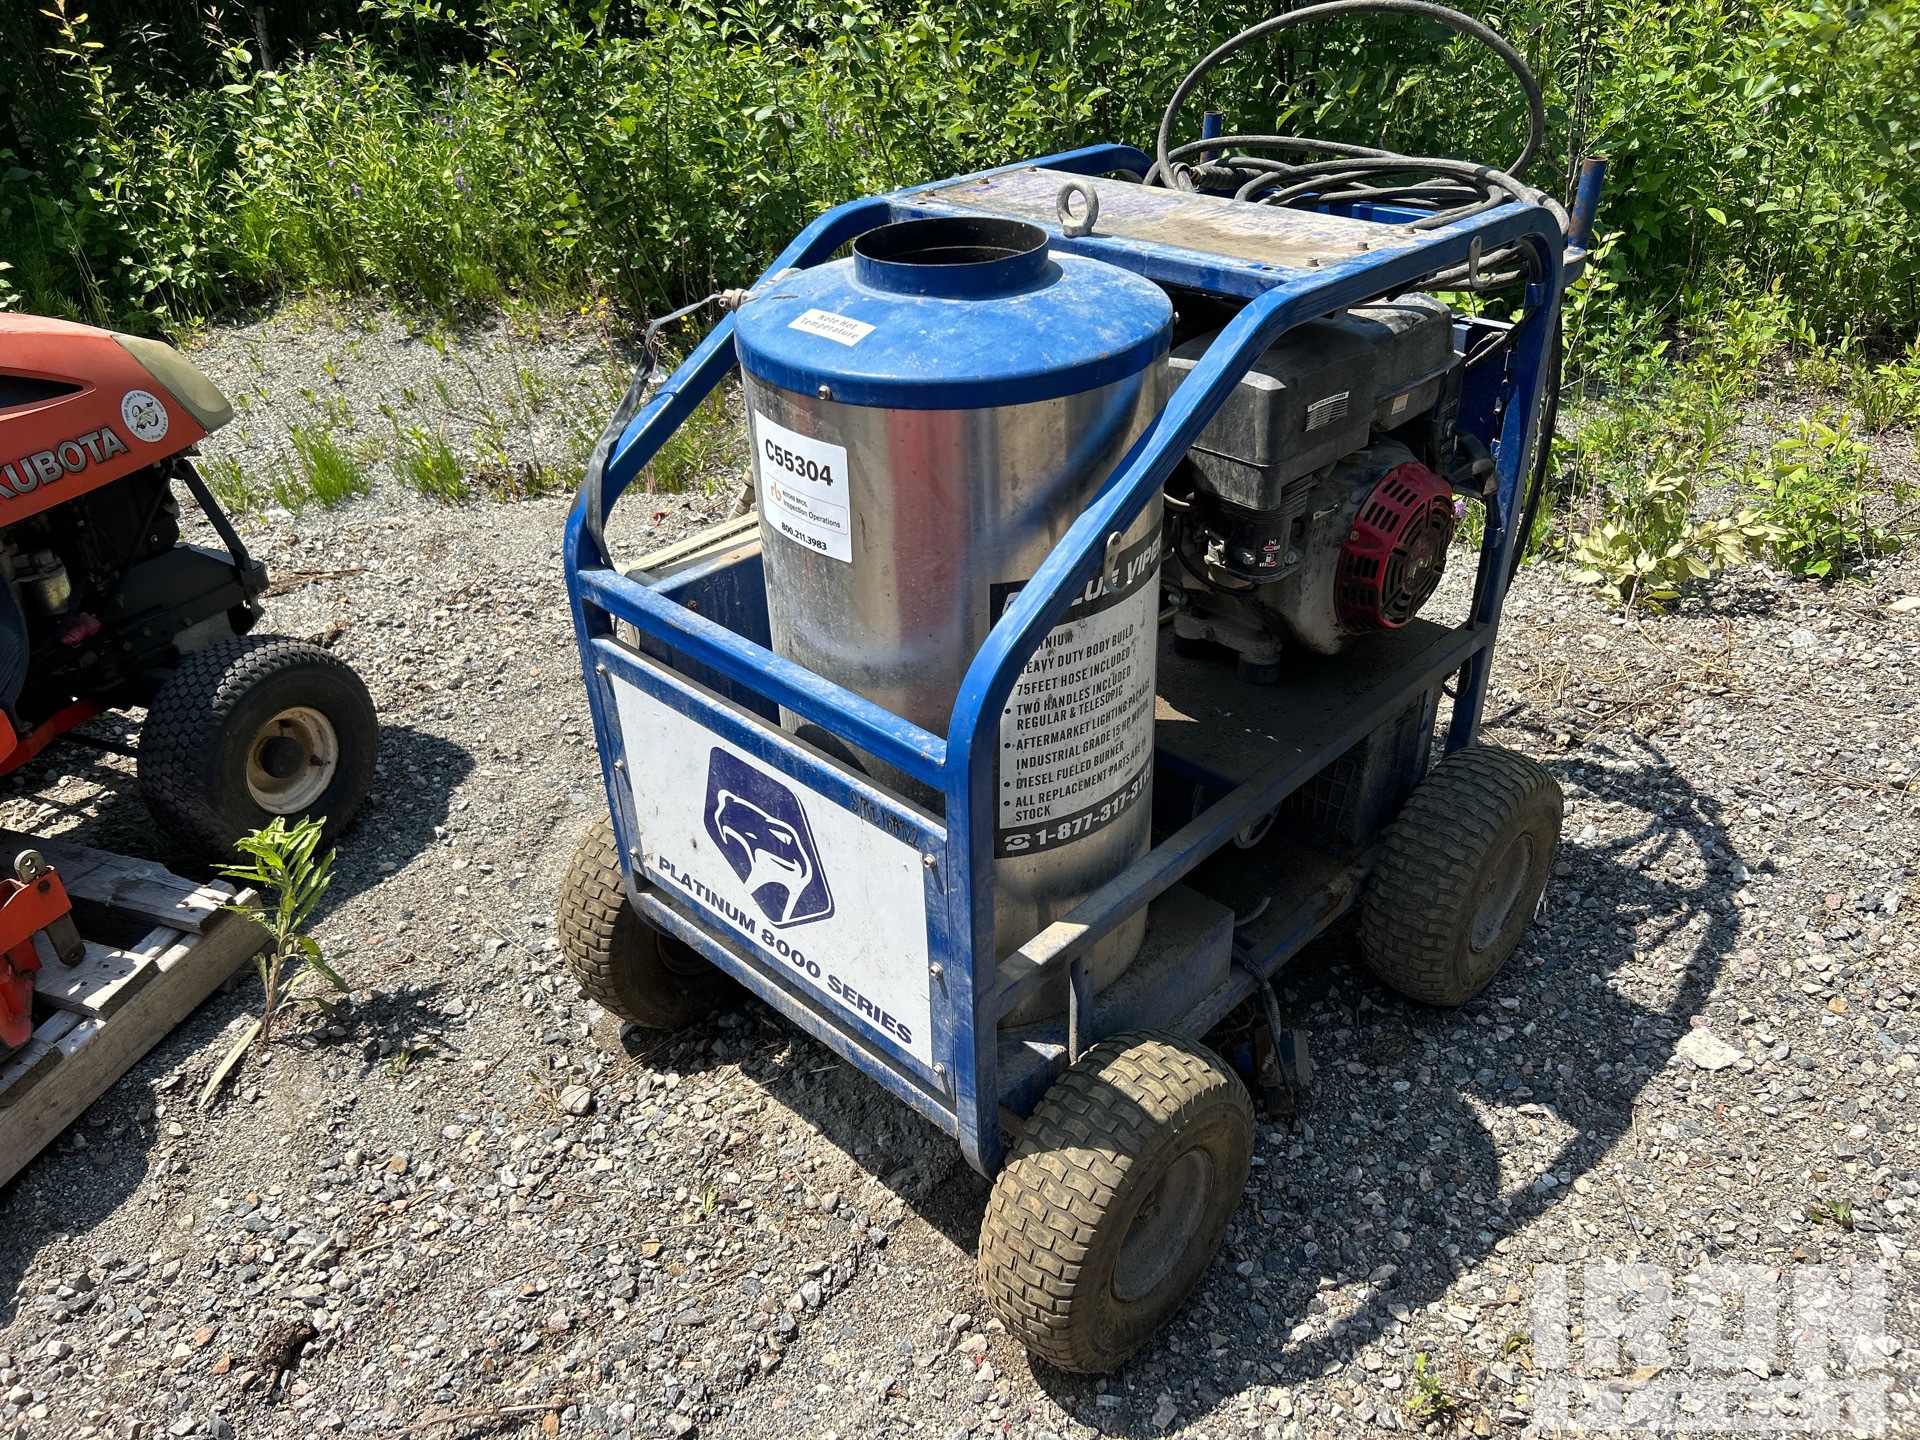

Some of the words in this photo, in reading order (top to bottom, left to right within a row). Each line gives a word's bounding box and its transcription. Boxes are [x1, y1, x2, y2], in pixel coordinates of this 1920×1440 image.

[800, 317, 859, 340] Temperature
[765, 438, 834, 487] C55304
[781, 521, 828, 551] 800.211.3983
[783, 499, 808, 517] Inspection
[808, 511, 841, 529] Operations
[1057, 648, 1084, 668] DUTY
[1086, 637, 1111, 658] BODY
[1111, 624, 1134, 647] BUILD
[1016, 677, 1058, 696] 75FEET
[1060, 668, 1088, 688] HOSE
[1090, 646, 1131, 677] INCLUDED
[1016, 701, 1040, 716] TWO
[1043, 687, 1091, 711] HANDLES
[1092, 665, 1131, 696] INCLUDED
[1016, 709, 1067, 731] REGULAR
[1069, 706, 1077, 719] &
[1079, 684, 1124, 715] TELESOPIC
[1016, 720, 1091, 751] AFTERMARKET
[1092, 700, 1128, 730] LIGHTING
[1016, 749, 1081, 770] INDUSTRIAL
[1082, 730, 1111, 753] GRADE
[1112, 724, 1121, 738] 15
[1121, 716, 1131, 732] HP
[1016, 771, 1054, 789] DIESEL
[1056, 758, 1092, 781] FUELED
[1093, 741, 1124, 767] BURNER
[1015, 794, 1036, 808] ALL
[1038, 768, 1108, 803] REPLACEMENT
[1108, 753, 1130, 777] PARTS
[1130, 742, 1142, 760] ARE
[1015, 805, 1051, 822] STOCK
[658, 855, 756, 935] PLATINUM
[761, 928, 821, 979] 8000
[828, 973, 913, 1045] SERIES
